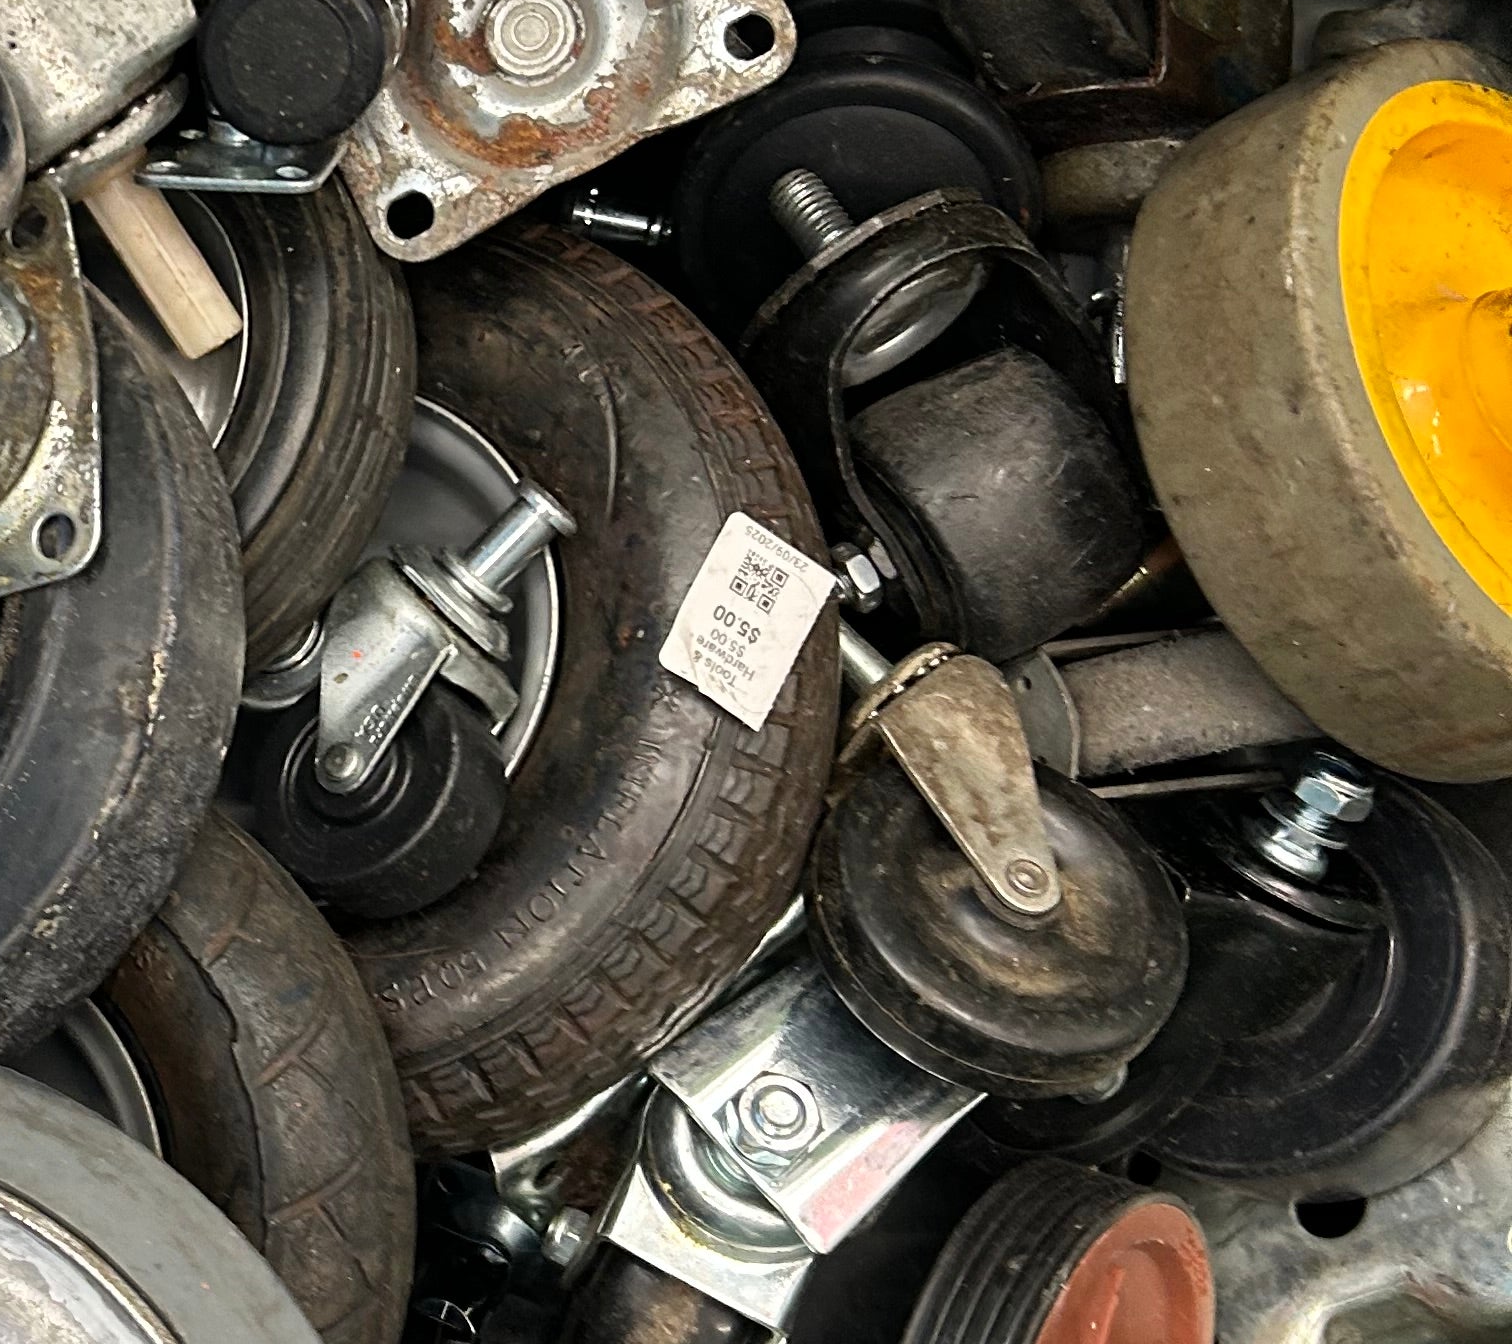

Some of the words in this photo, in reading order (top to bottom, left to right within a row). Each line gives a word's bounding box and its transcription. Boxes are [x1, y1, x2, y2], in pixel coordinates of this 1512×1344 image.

[745, 525, 809, 573] 23/09/2025
[713, 605, 761, 644] $5.00
[693, 650, 703, 663] &
[696, 635, 756, 681] Hardware
[710, 628, 747, 658] $5.00
[704, 657, 737, 688] Tools
